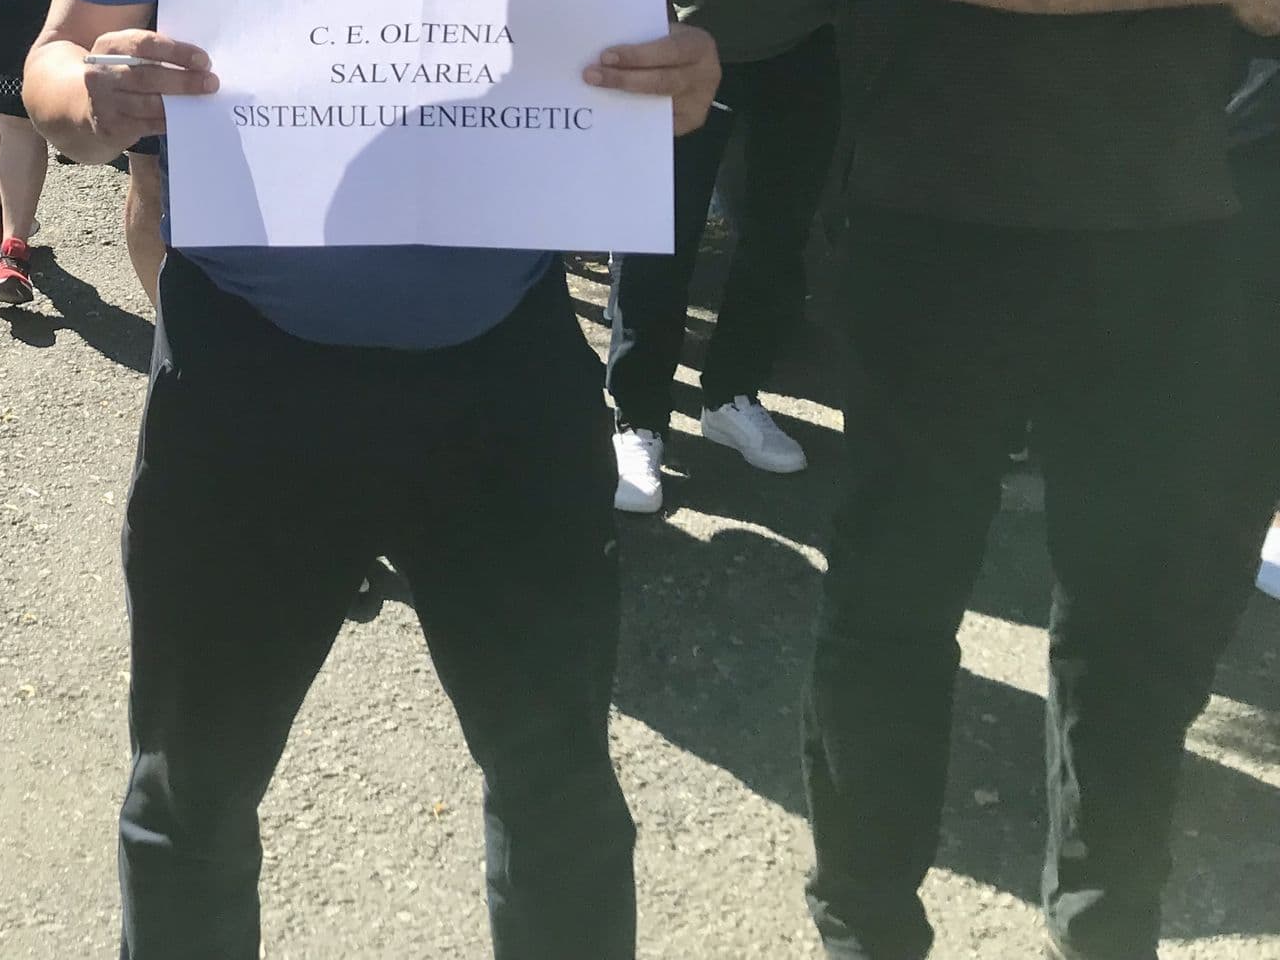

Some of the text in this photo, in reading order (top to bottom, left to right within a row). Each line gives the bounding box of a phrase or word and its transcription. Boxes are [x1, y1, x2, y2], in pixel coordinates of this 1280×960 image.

[309, 23, 514, 45] C. E. OLTENIA
[331, 63, 495, 83] SALVAREA
[233, 105, 593, 130] SISTEMULUI ENERGETIC
